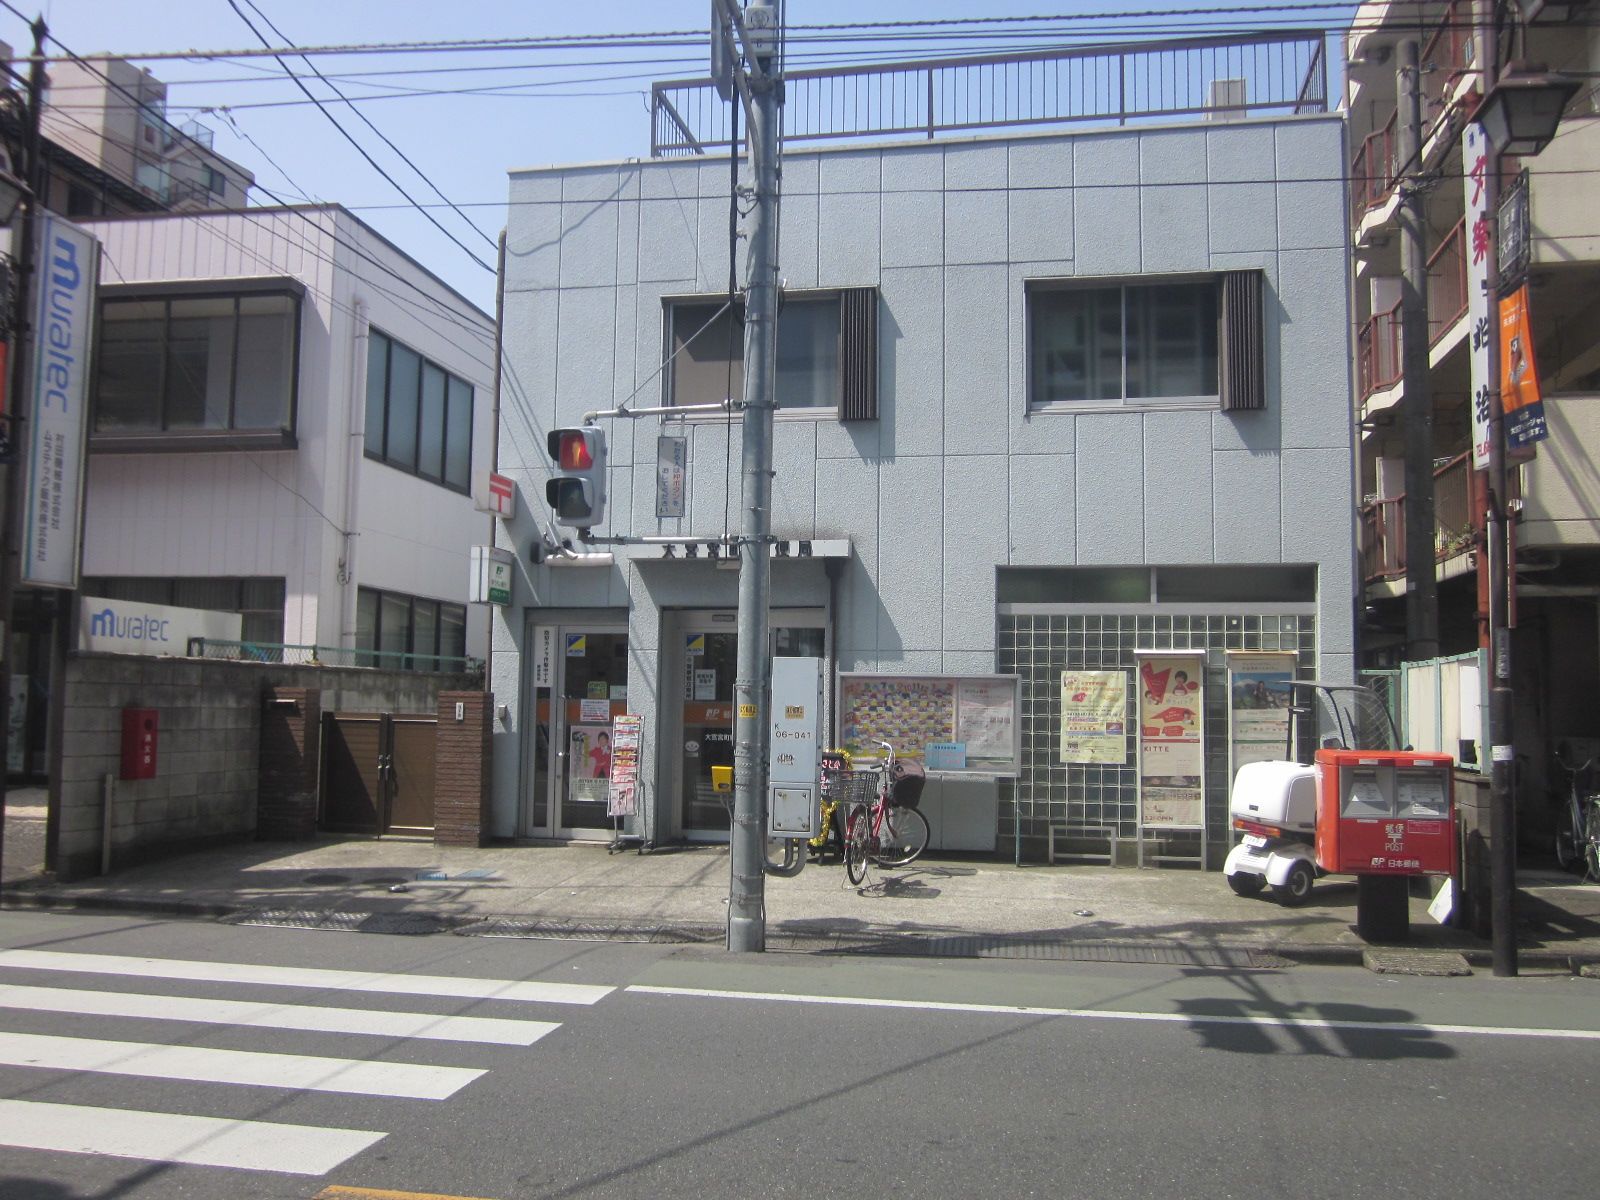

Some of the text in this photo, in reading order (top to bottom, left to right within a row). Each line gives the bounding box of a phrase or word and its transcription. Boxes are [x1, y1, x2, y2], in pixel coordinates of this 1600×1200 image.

[45, 236, 82, 413] muratec
[662, 541, 813, 558] 大宮宮町便局
[91, 608, 169, 642] muratec
[775, 731, 811, 739] 06-041
[1385, 823, 1404, 834] 郵便
[1385, 843, 1404, 852] POST
[1388, 859, 1420, 868] 日本郵便
